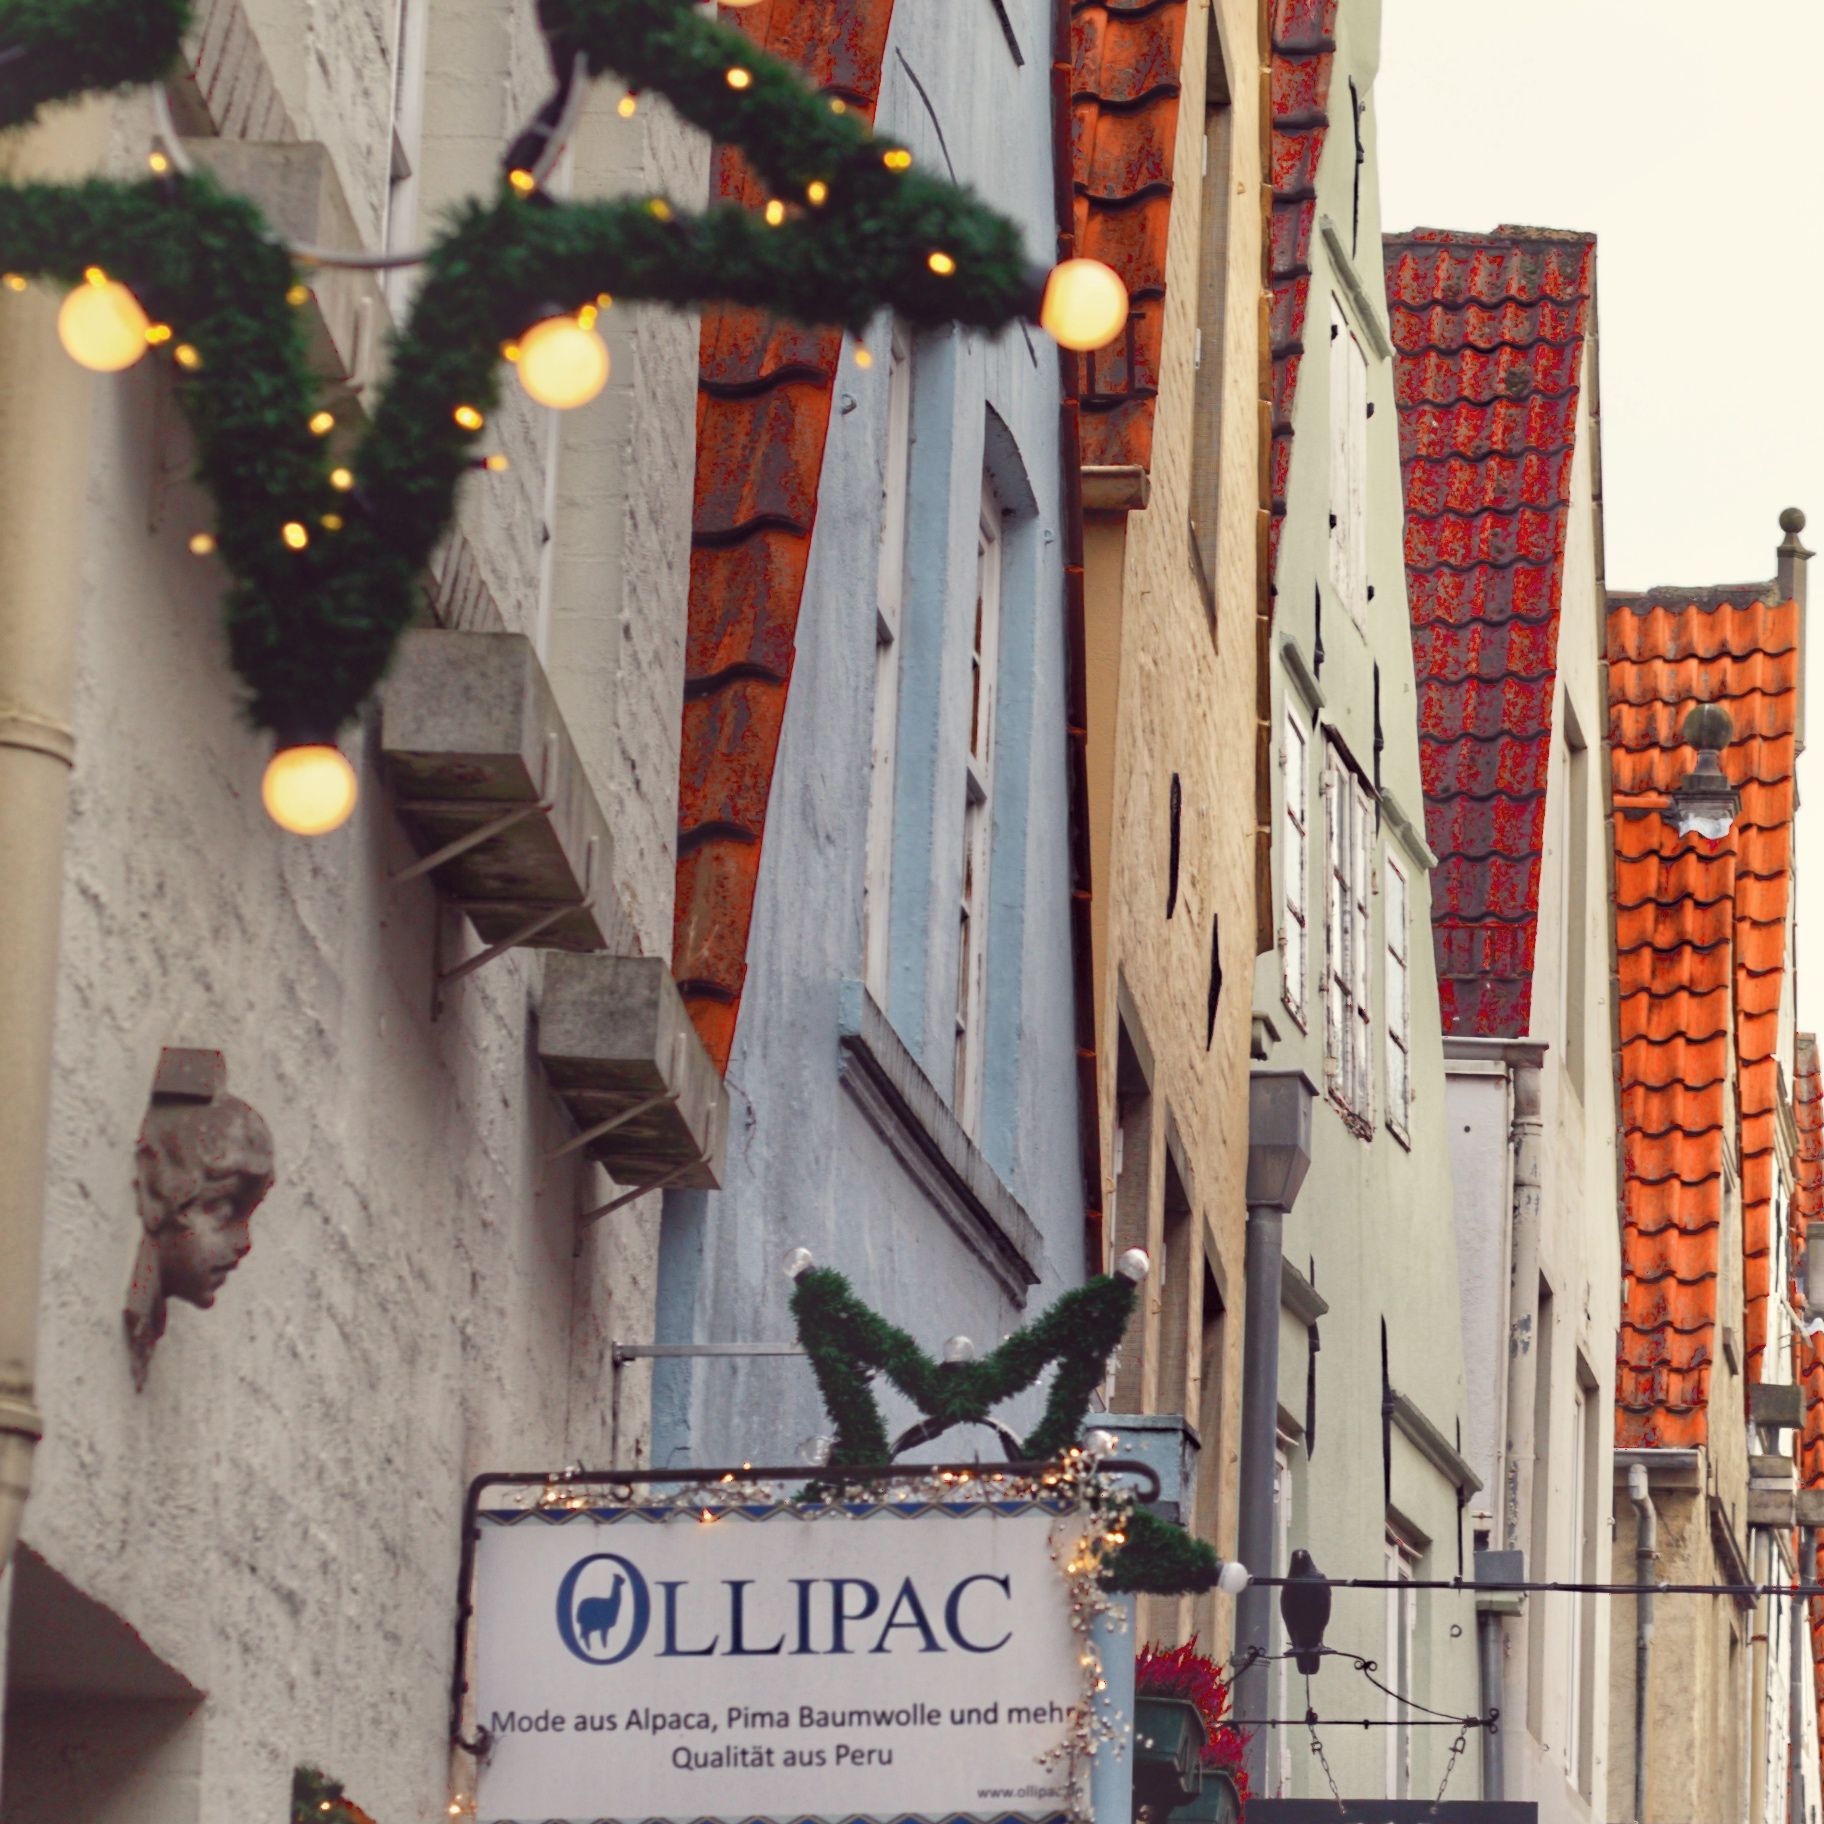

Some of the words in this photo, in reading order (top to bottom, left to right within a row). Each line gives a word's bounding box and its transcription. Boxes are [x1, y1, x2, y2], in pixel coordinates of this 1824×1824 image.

[556, 1552, 1013, 1666] OLLIPAC
[491, 1710, 566, 1732] Mode
[573, 1712, 618, 1731] aus
[625, 1707, 718, 1735] Alpaca,
[727, 1706, 790, 1729] Pima
[799, 1702, 942, 1727] Baumwolle
[950, 1701, 998, 1725] und
[671, 1745, 774, 1771] Qualität
[783, 1748, 827, 1767] aus
[835, 1744, 893, 1766] Peru
